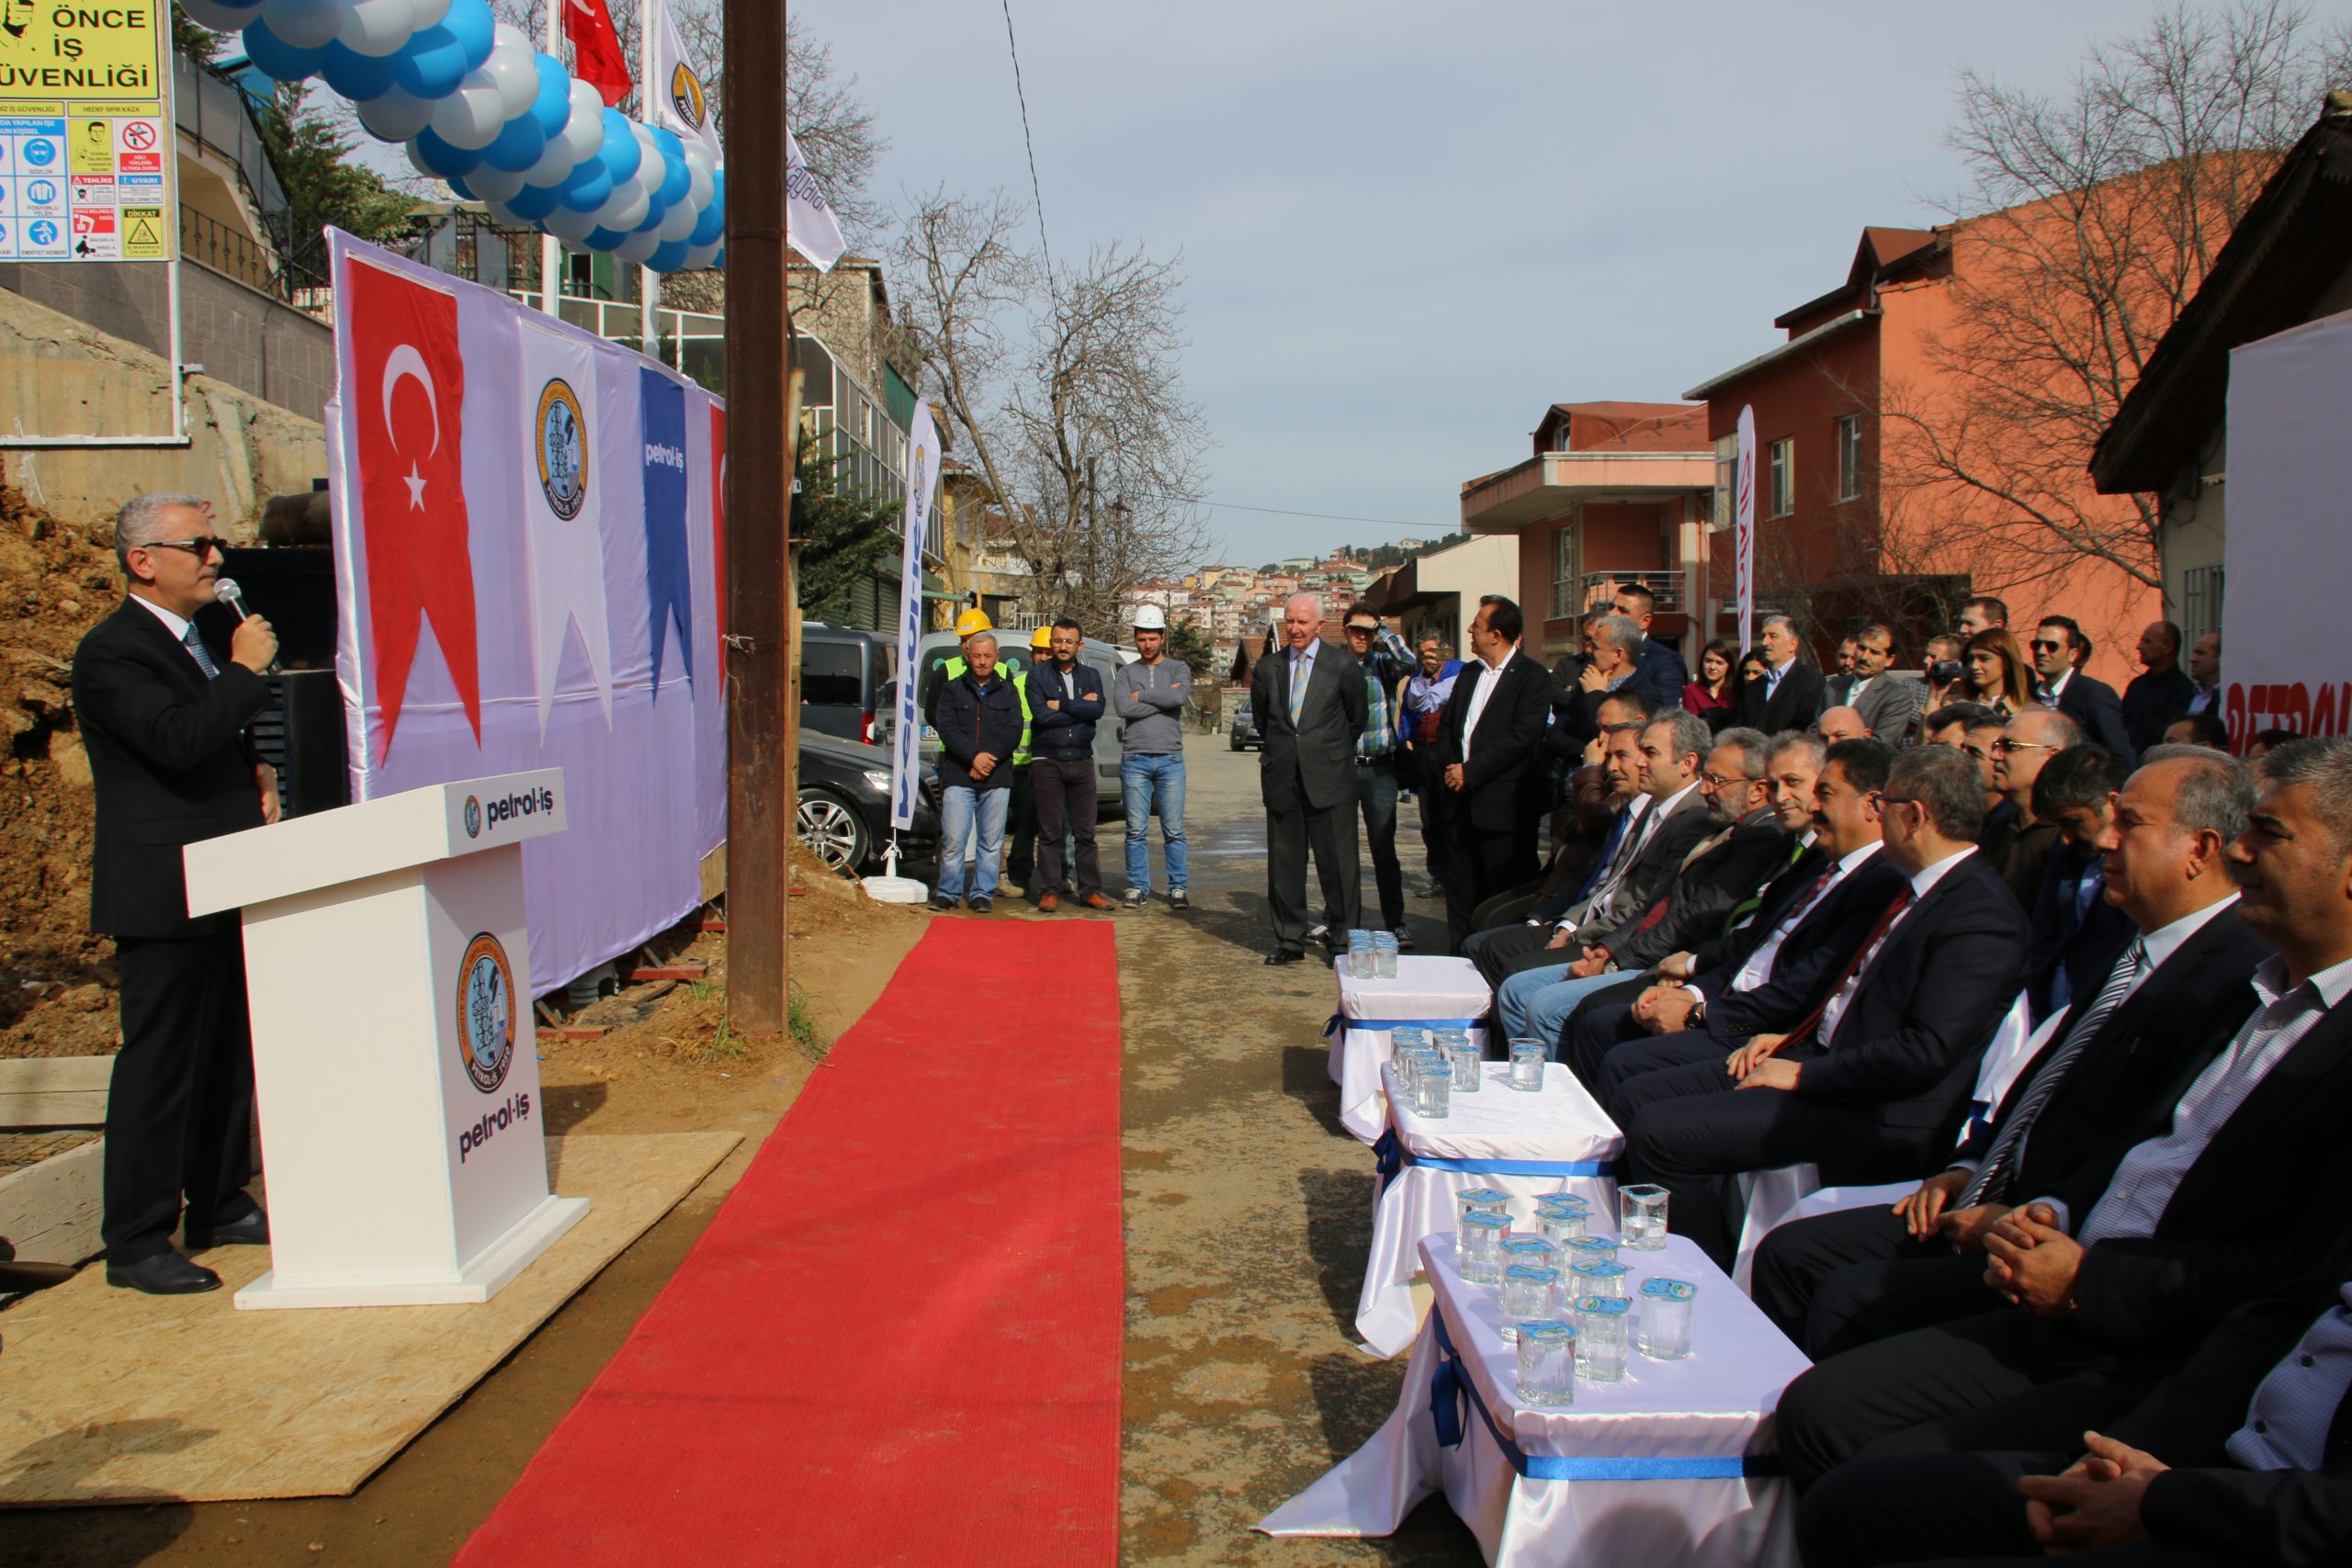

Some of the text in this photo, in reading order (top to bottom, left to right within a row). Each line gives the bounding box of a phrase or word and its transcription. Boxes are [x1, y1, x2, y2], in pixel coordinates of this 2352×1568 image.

[52, 5, 146, 28] ÖNCE
[54, 34, 84, 62] İŞ
[0, 63, 148, 87] ÜVENLİĞİ
[17, 104, 55, 112] GÜVENLİĞİ
